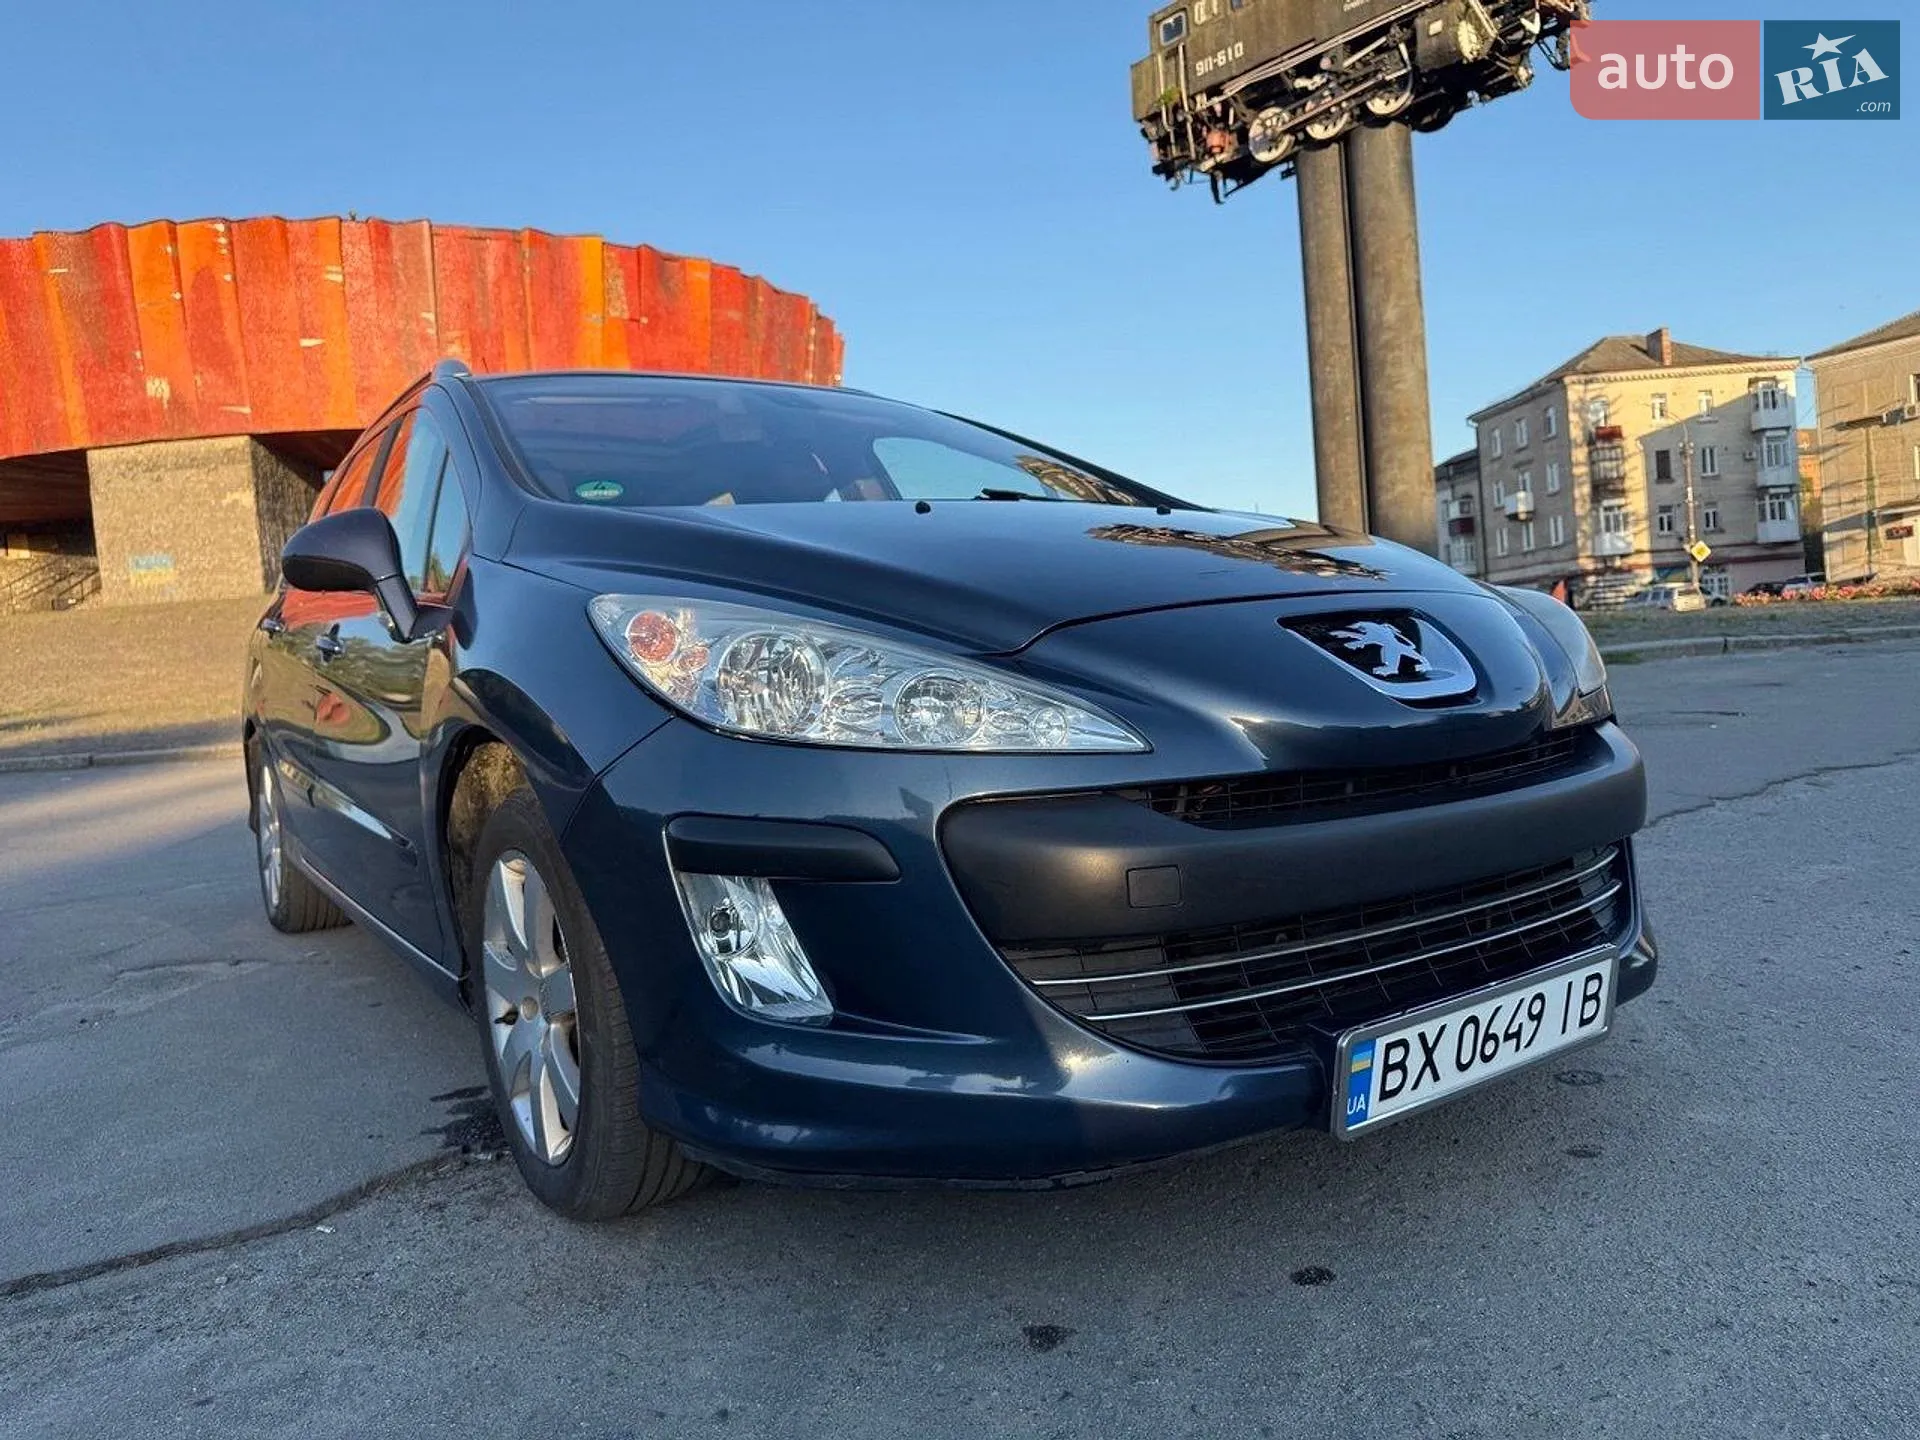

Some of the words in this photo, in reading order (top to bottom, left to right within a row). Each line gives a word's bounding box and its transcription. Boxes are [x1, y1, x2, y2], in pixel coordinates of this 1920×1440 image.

[1378, 1023, 1448, 1102] BX
[1455, 991, 1547, 1073] 0649
[1561, 971, 1603, 1035] IB
[1347, 1093, 1366, 1115] UA
